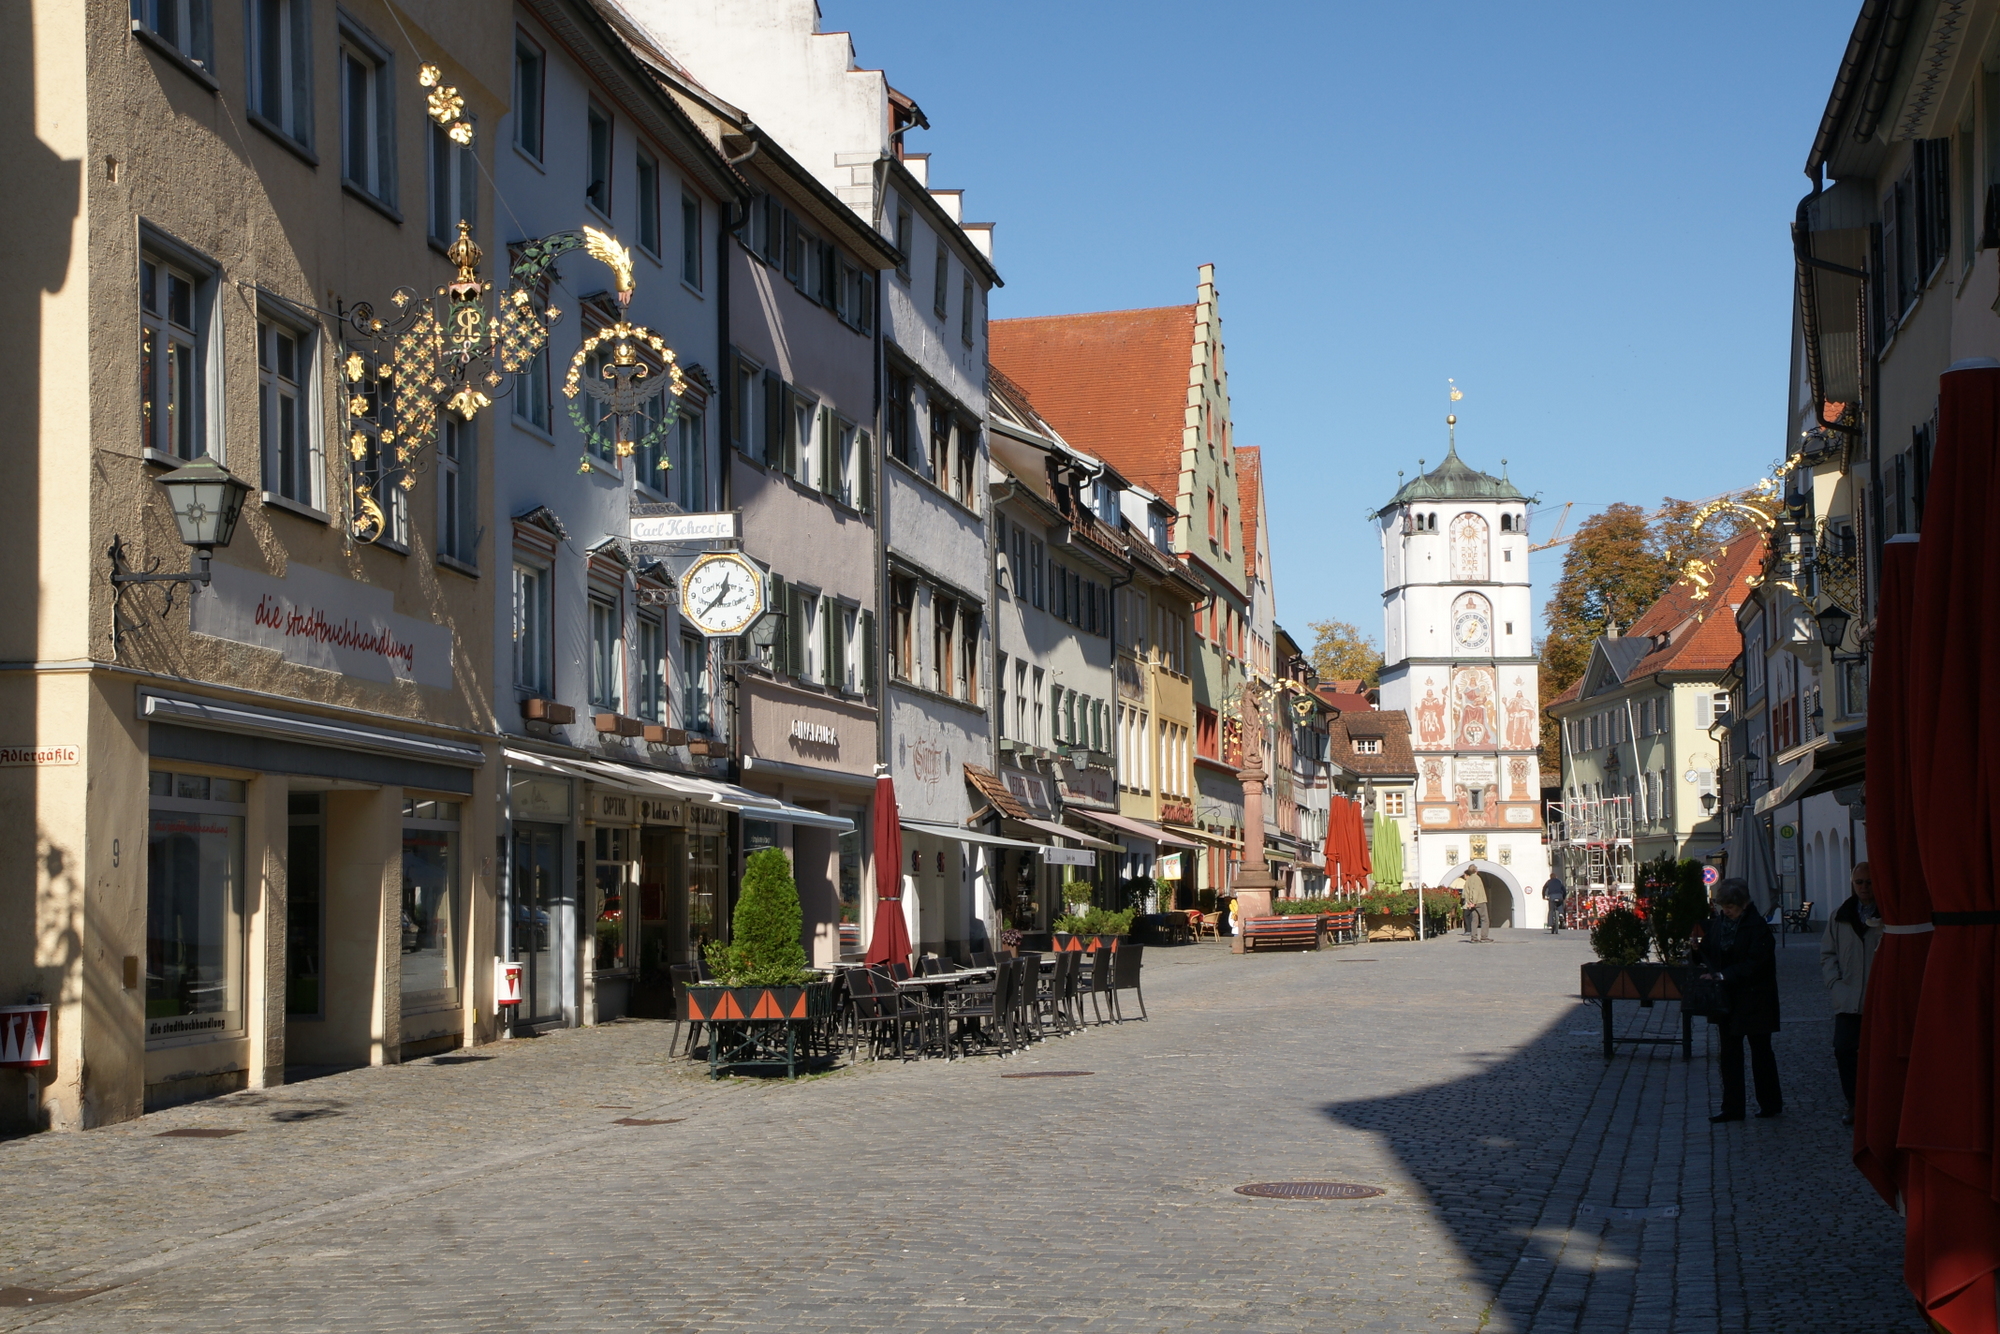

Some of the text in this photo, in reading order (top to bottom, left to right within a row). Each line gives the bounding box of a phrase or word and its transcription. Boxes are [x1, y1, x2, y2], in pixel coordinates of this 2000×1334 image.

[633, 521, 665, 538] Carl
[665, 519, 714, 537] Kehrer
[718, 560, 726, 568] 12
[735, 564, 739, 572] 1
[704, 565, 710, 573] 11
[694, 576, 702, 584] 10
[702, 583, 715, 594] Carl
[749, 588, 755, 597] 3
[696, 607, 701, 615] 8
[708, 617, 713, 625] 7
[721, 619, 726, 627] 6
[737, 615, 742, 623] 5
[255, 594, 414, 671] die stadtbuchhandlung
[603, 796, 627, 816] OPTIK
[112, 838, 120, 868] 9
[150, 1017, 226, 1035] die stadtbuchhandlung
